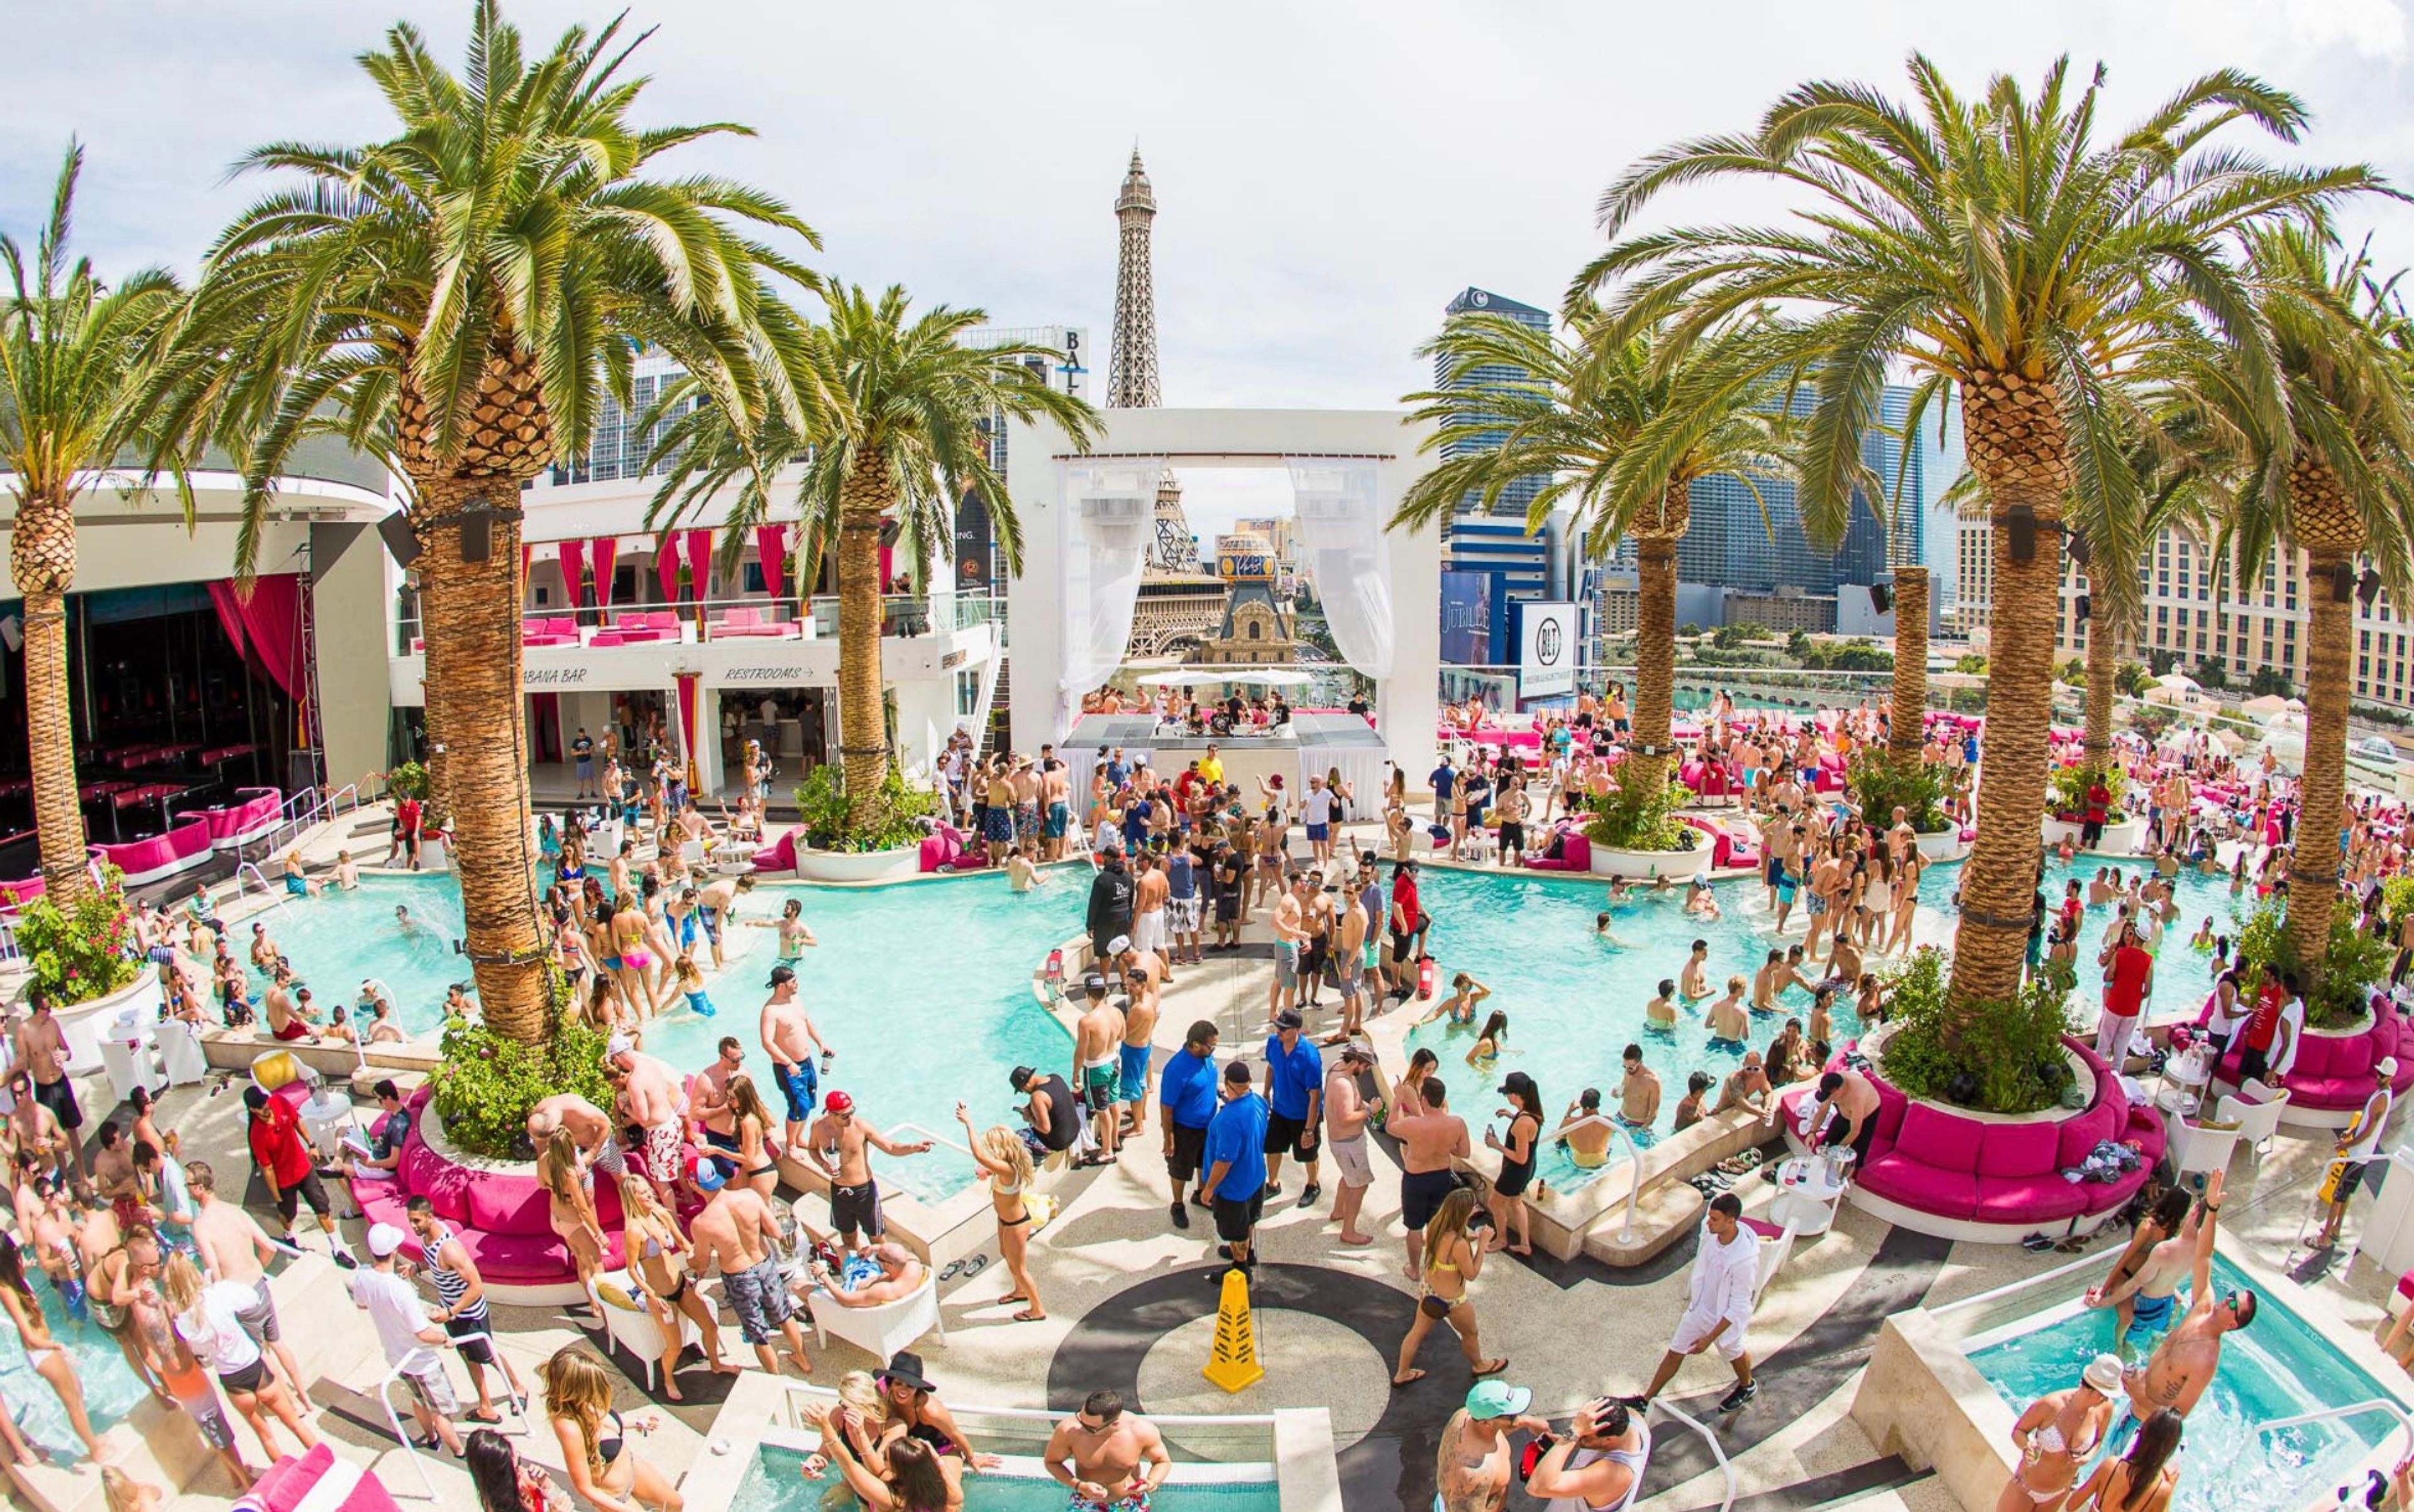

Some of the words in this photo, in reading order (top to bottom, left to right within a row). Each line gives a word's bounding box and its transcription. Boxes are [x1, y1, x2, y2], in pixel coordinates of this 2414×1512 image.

[956, 531, 976, 539] ING.
[1541, 628, 1557, 657] BLT
[561, 668, 587, 683] BAR
[725, 667, 802, 680] RESTROOMS
